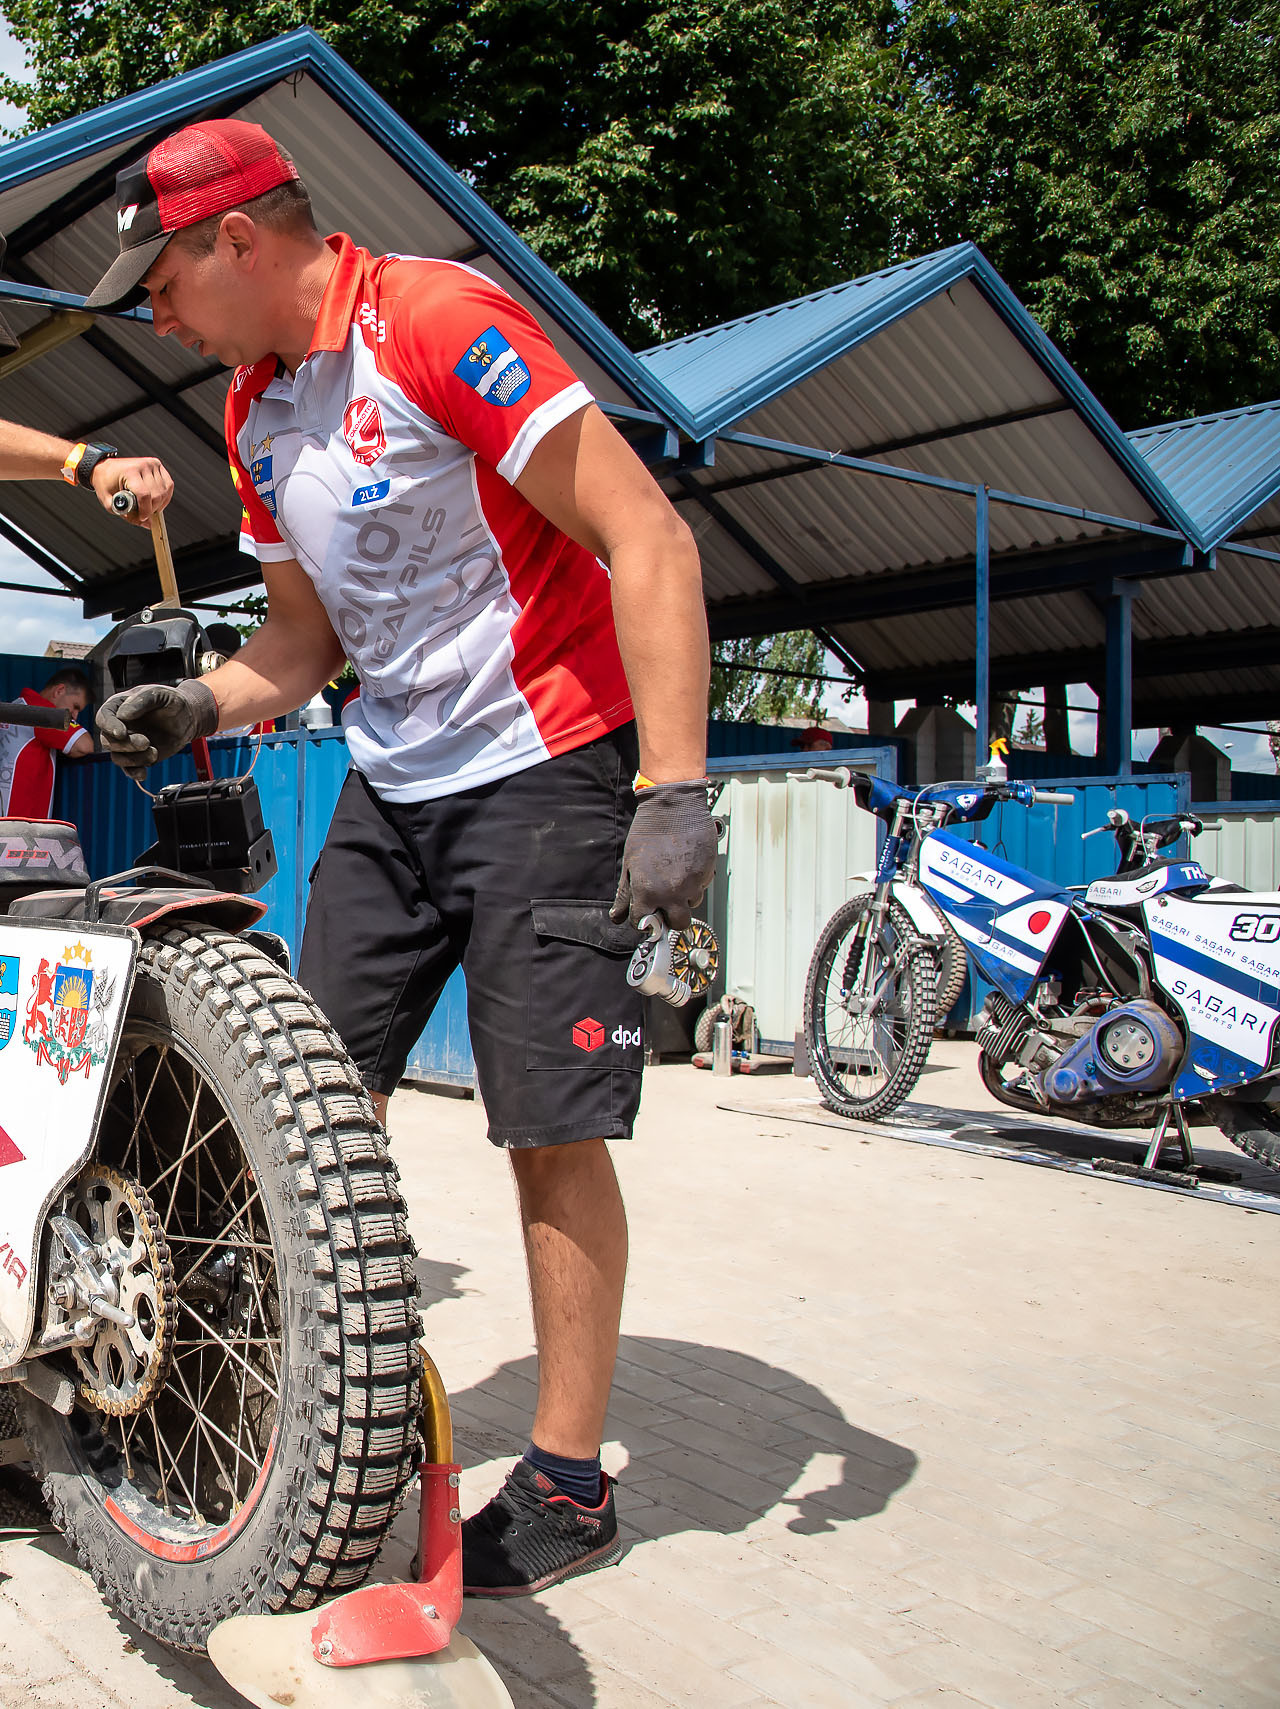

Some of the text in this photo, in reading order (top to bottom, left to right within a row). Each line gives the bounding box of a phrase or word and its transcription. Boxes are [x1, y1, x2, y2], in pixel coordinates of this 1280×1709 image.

[348, 401, 373, 442] LOKOMOTIV
[940, 850, 1003, 890] SAGARI
[1089, 886, 1122, 896] SAGARI
[1151, 915, 1190, 937] SAGARI
[1194, 934, 1236, 958] SAGARI
[1240, 955, 1280, 978] SAGAR
[1171, 980, 1268, 1034] SAGARI
[1190, 1006, 1233, 1030] SPORTS
[611, 1024, 641, 1050] dpd
